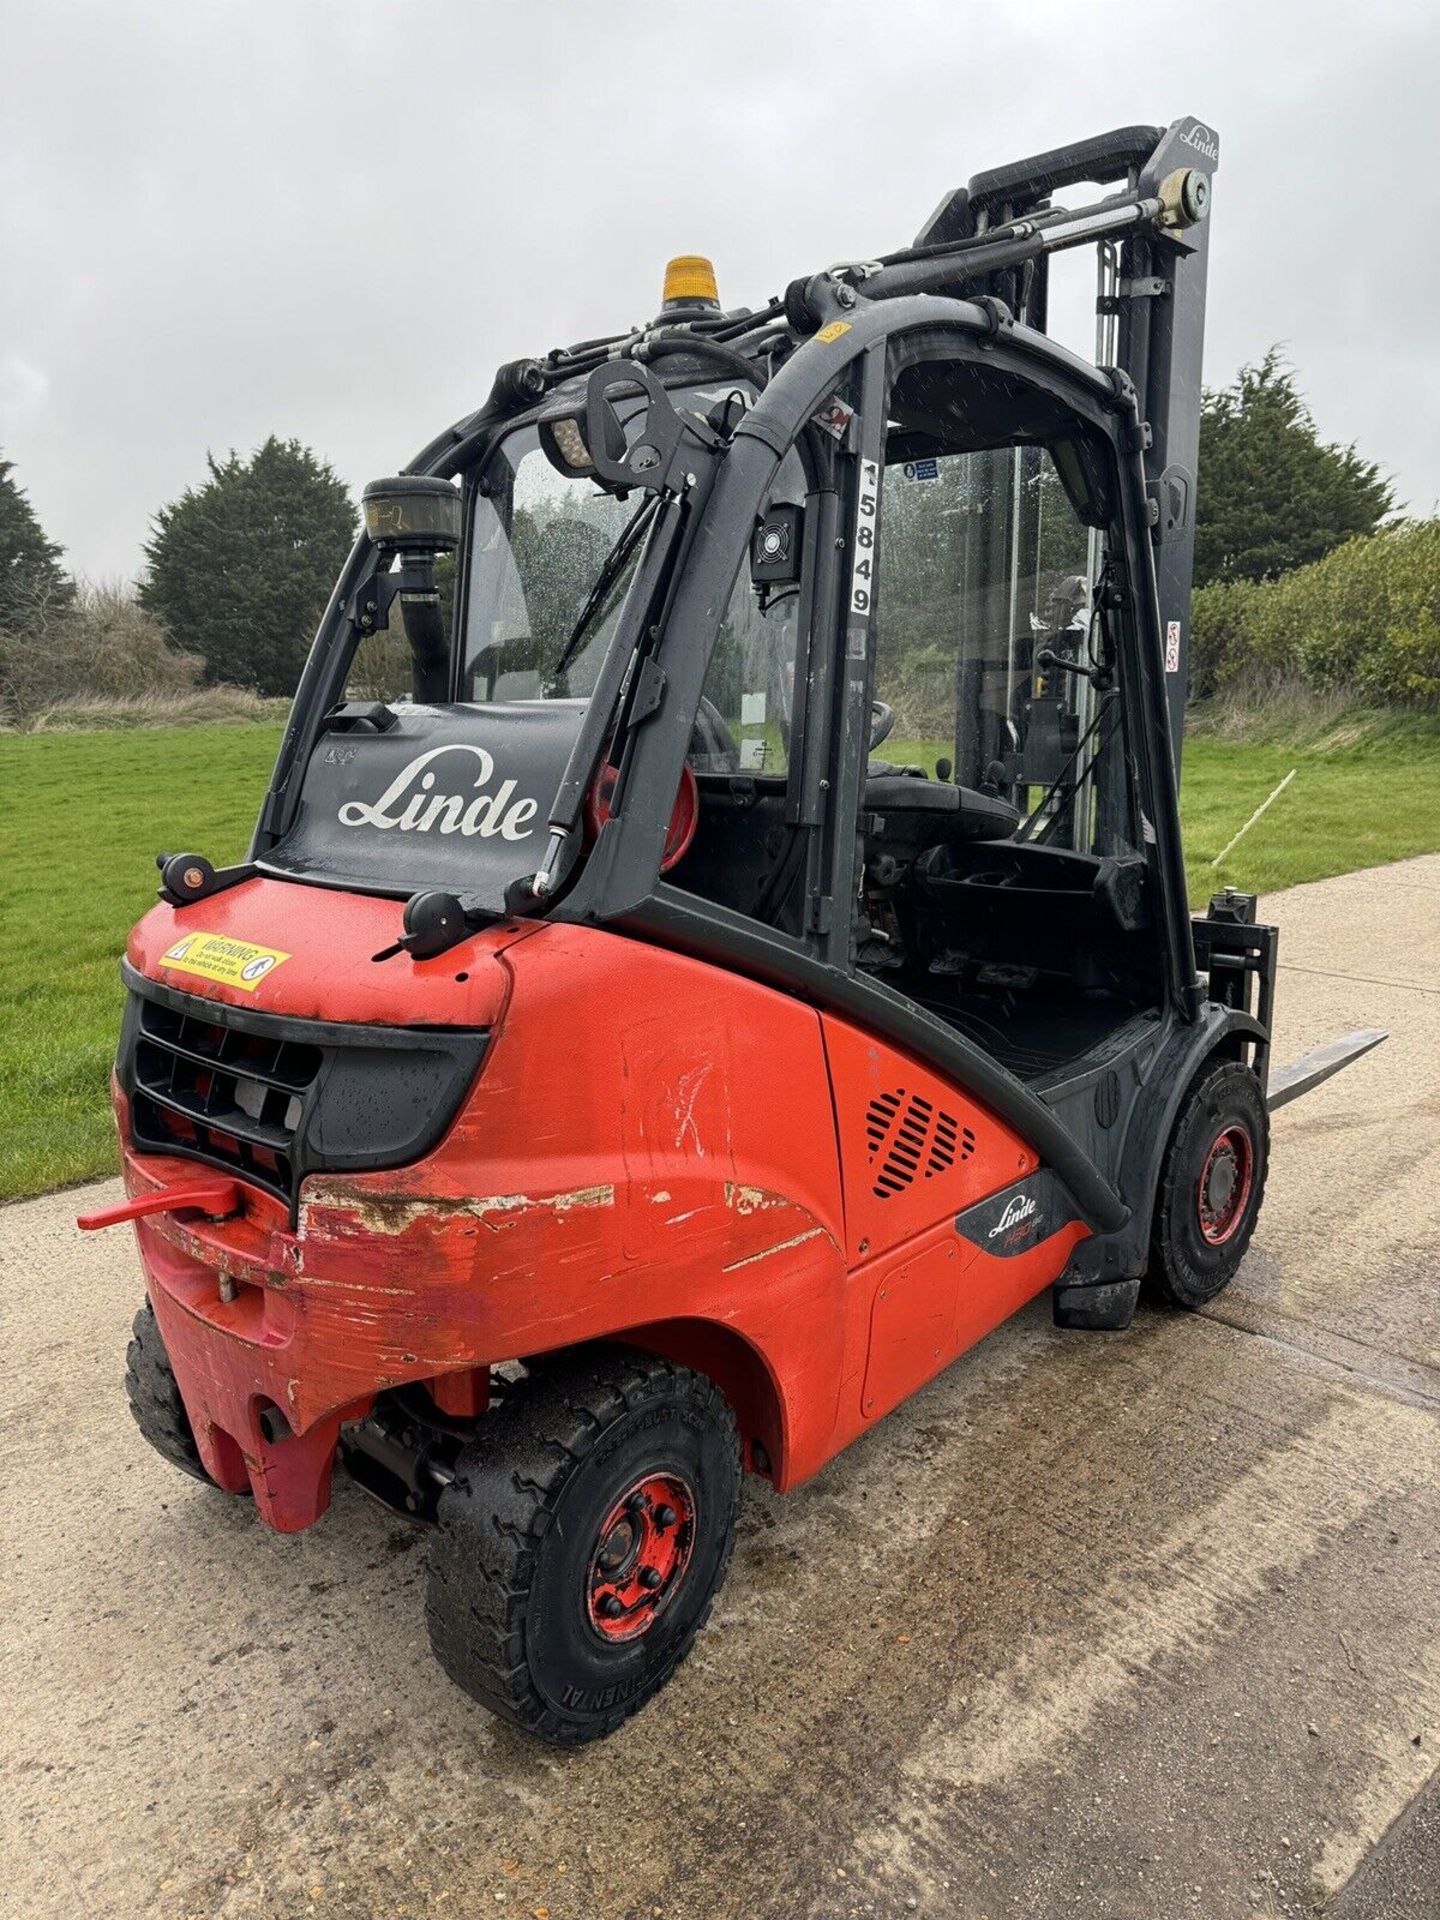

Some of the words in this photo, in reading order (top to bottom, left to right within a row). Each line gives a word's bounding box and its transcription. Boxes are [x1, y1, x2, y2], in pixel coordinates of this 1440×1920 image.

[1179, 124, 1218, 160] Linde
[338, 744, 538, 841] Linde
[201, 939, 259, 960] WARNING
[988, 1194, 1036, 1238] Linde
